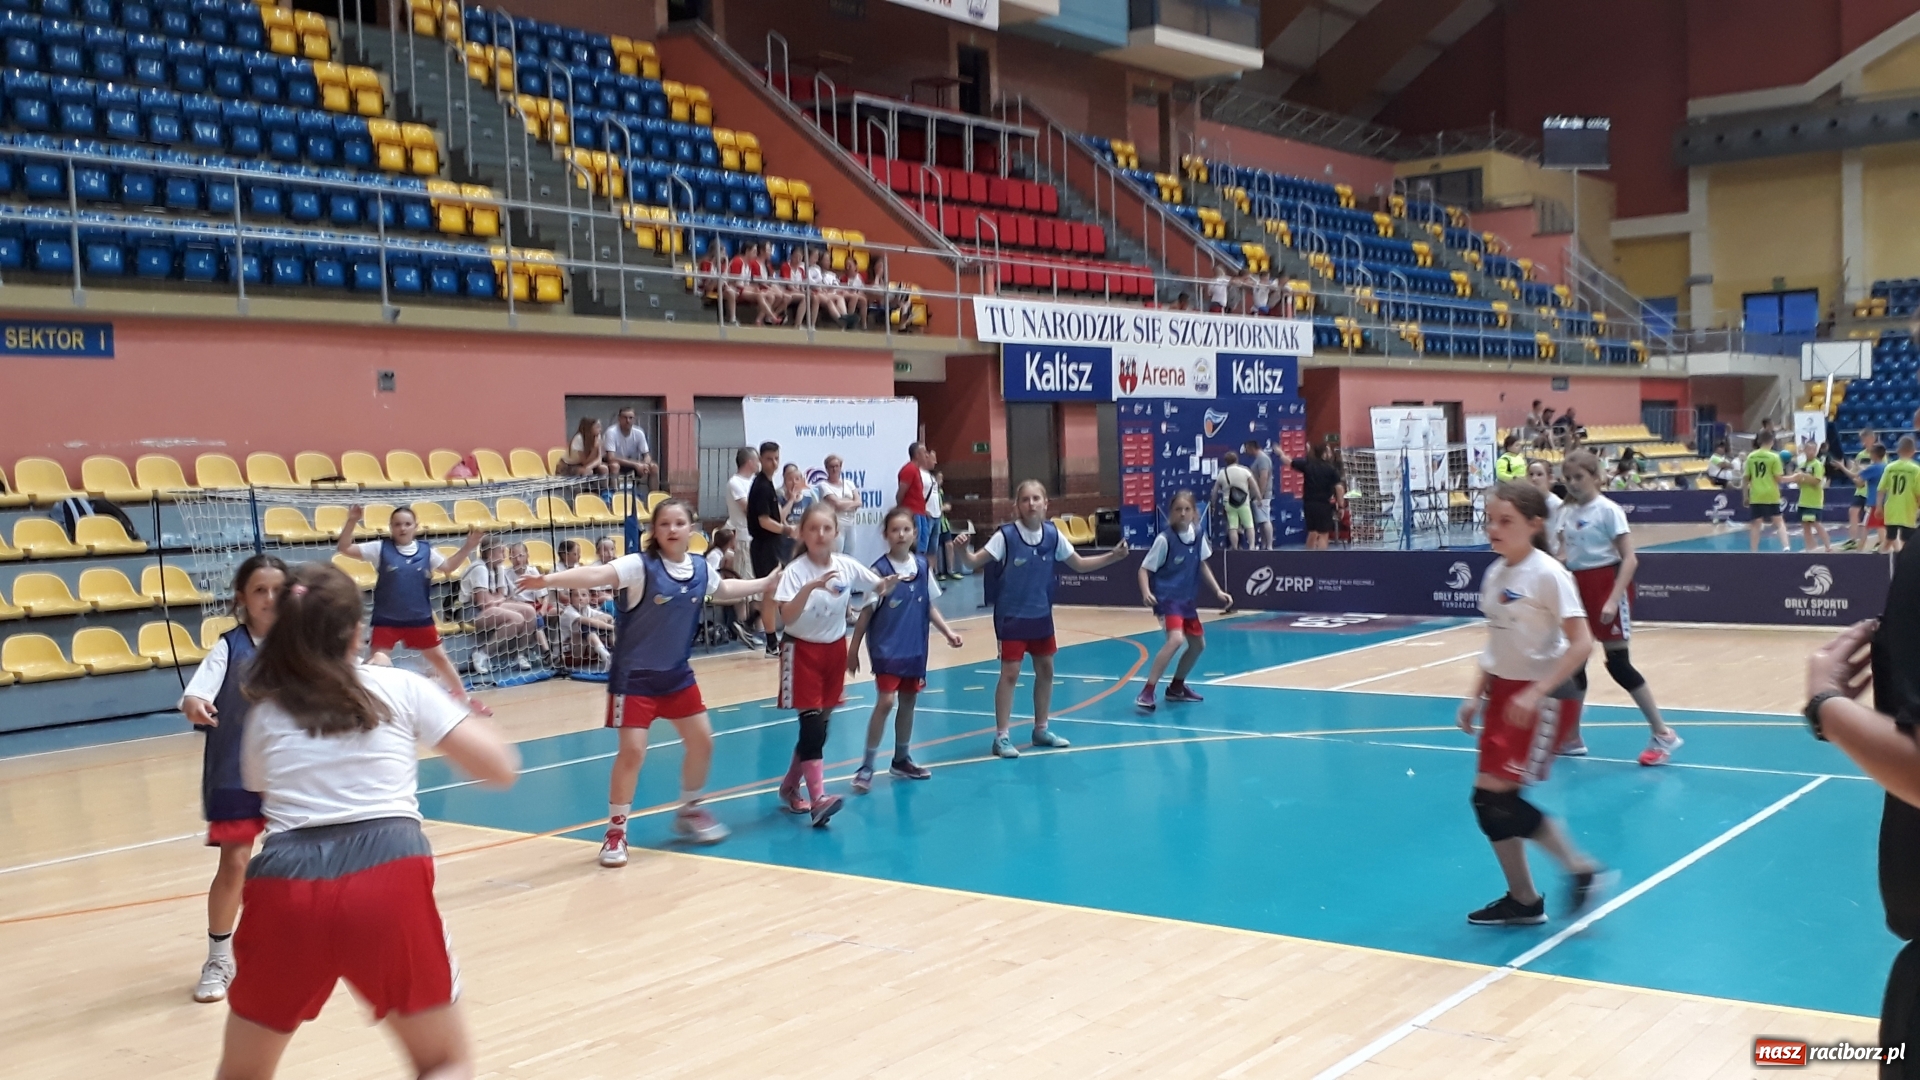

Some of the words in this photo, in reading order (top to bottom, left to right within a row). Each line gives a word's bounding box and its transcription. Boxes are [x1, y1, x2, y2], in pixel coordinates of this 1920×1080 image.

[5, 326, 85, 350] SEKTOR
[985, 304, 1015, 338] TU
[1021, 308, 1129, 343] NARODZIŁ
[1133, 314, 1163, 348] SIĘ
[1169, 317, 1300, 350] SZCZYPIORNIAK
[1025, 350, 1093, 392] Kalisz
[1142, 359, 1186, 387] Arena
[1232, 358, 1284, 394] Kalisz
[794, 420, 876, 440] www.orlysportu.pl
[1754, 461, 1767, 479] 19
[1892, 474, 1906, 496] 10
[1275, 576, 1314, 592] ZPRP
[1795, 608, 1837, 617] FUNDACJA
[1810, 598, 1848, 610] SPORTU
